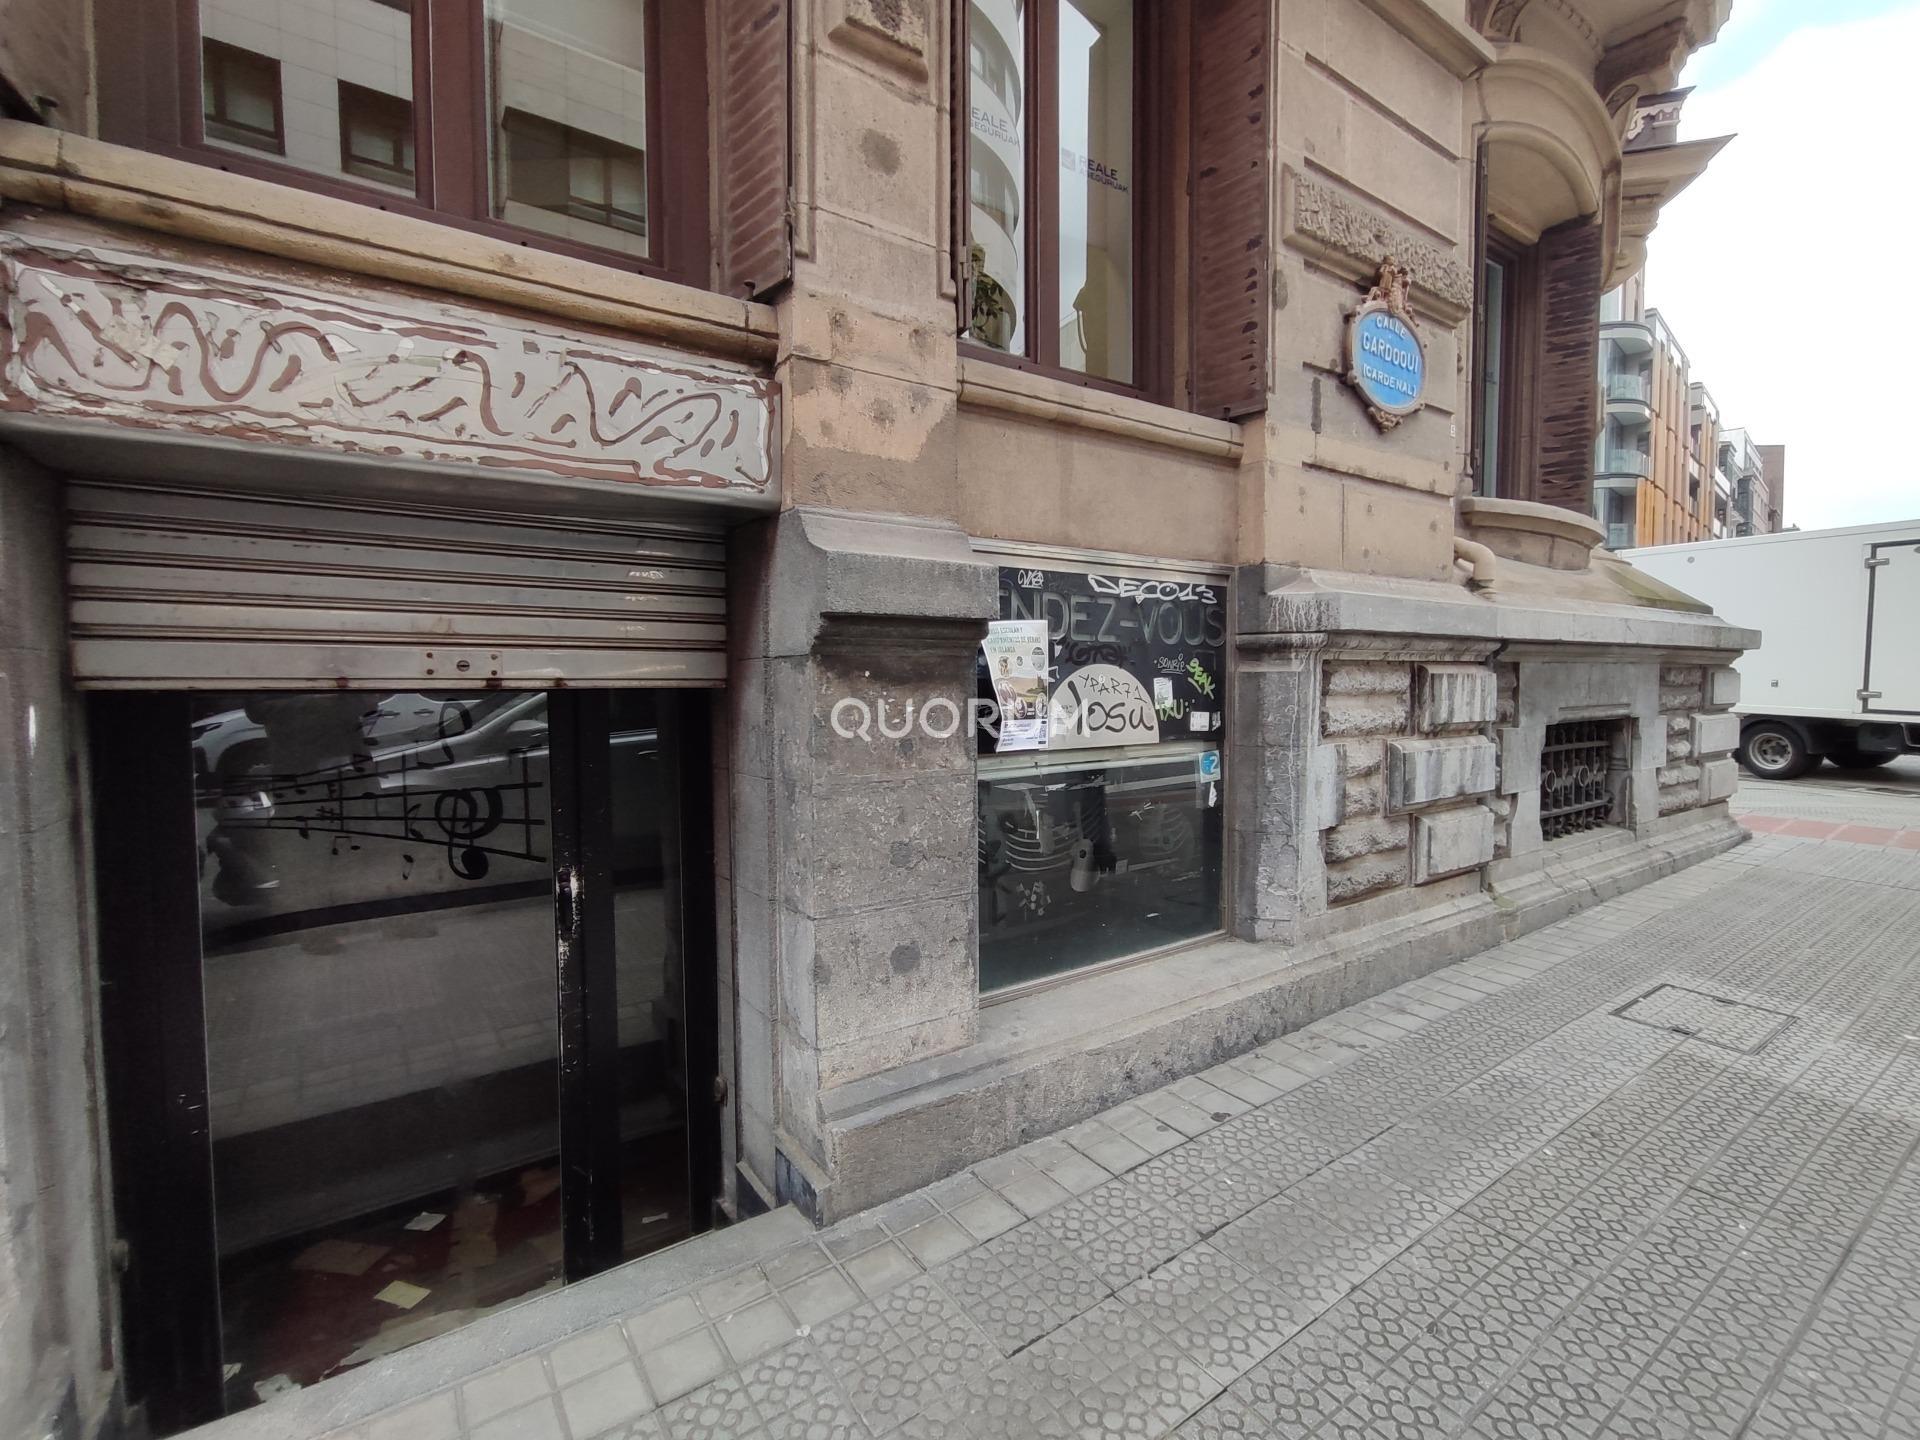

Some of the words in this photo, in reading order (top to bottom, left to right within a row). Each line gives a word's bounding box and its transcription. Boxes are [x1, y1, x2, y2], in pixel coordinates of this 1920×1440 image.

[971, 107, 1008, 133] EALE
[1079, 155, 1118, 181] REALE
[1376, 316, 1407, 339] CALLE
[1362, 332, 1419, 373] GARDOQUI
[999, 588, 1225, 648] NDEZ-VOUS
